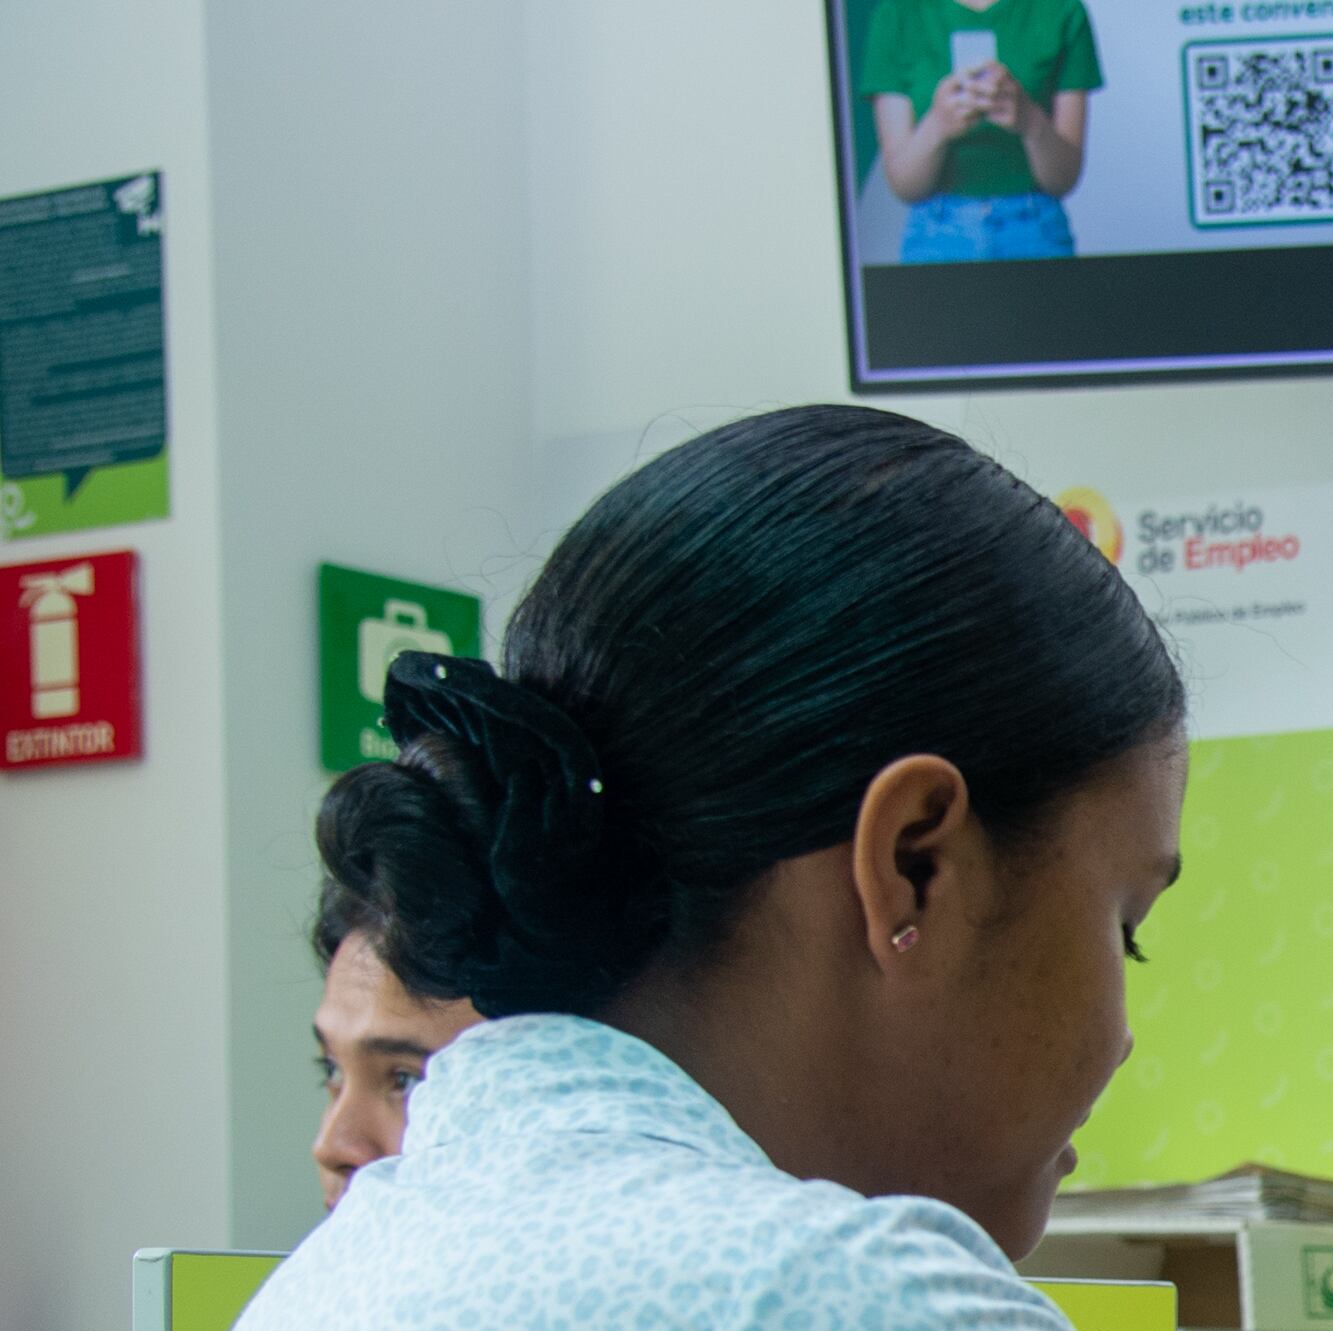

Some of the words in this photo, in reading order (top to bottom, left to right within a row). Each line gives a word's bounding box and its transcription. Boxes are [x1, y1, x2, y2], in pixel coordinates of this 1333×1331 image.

[1181, 5, 1233, 24] este
[1138, 500, 1263, 543] Servicio
[1138, 545, 1175, 574] de
[1184, 532, 1301, 574] Empleo
[6, 720, 115, 762] EXTINTOR
